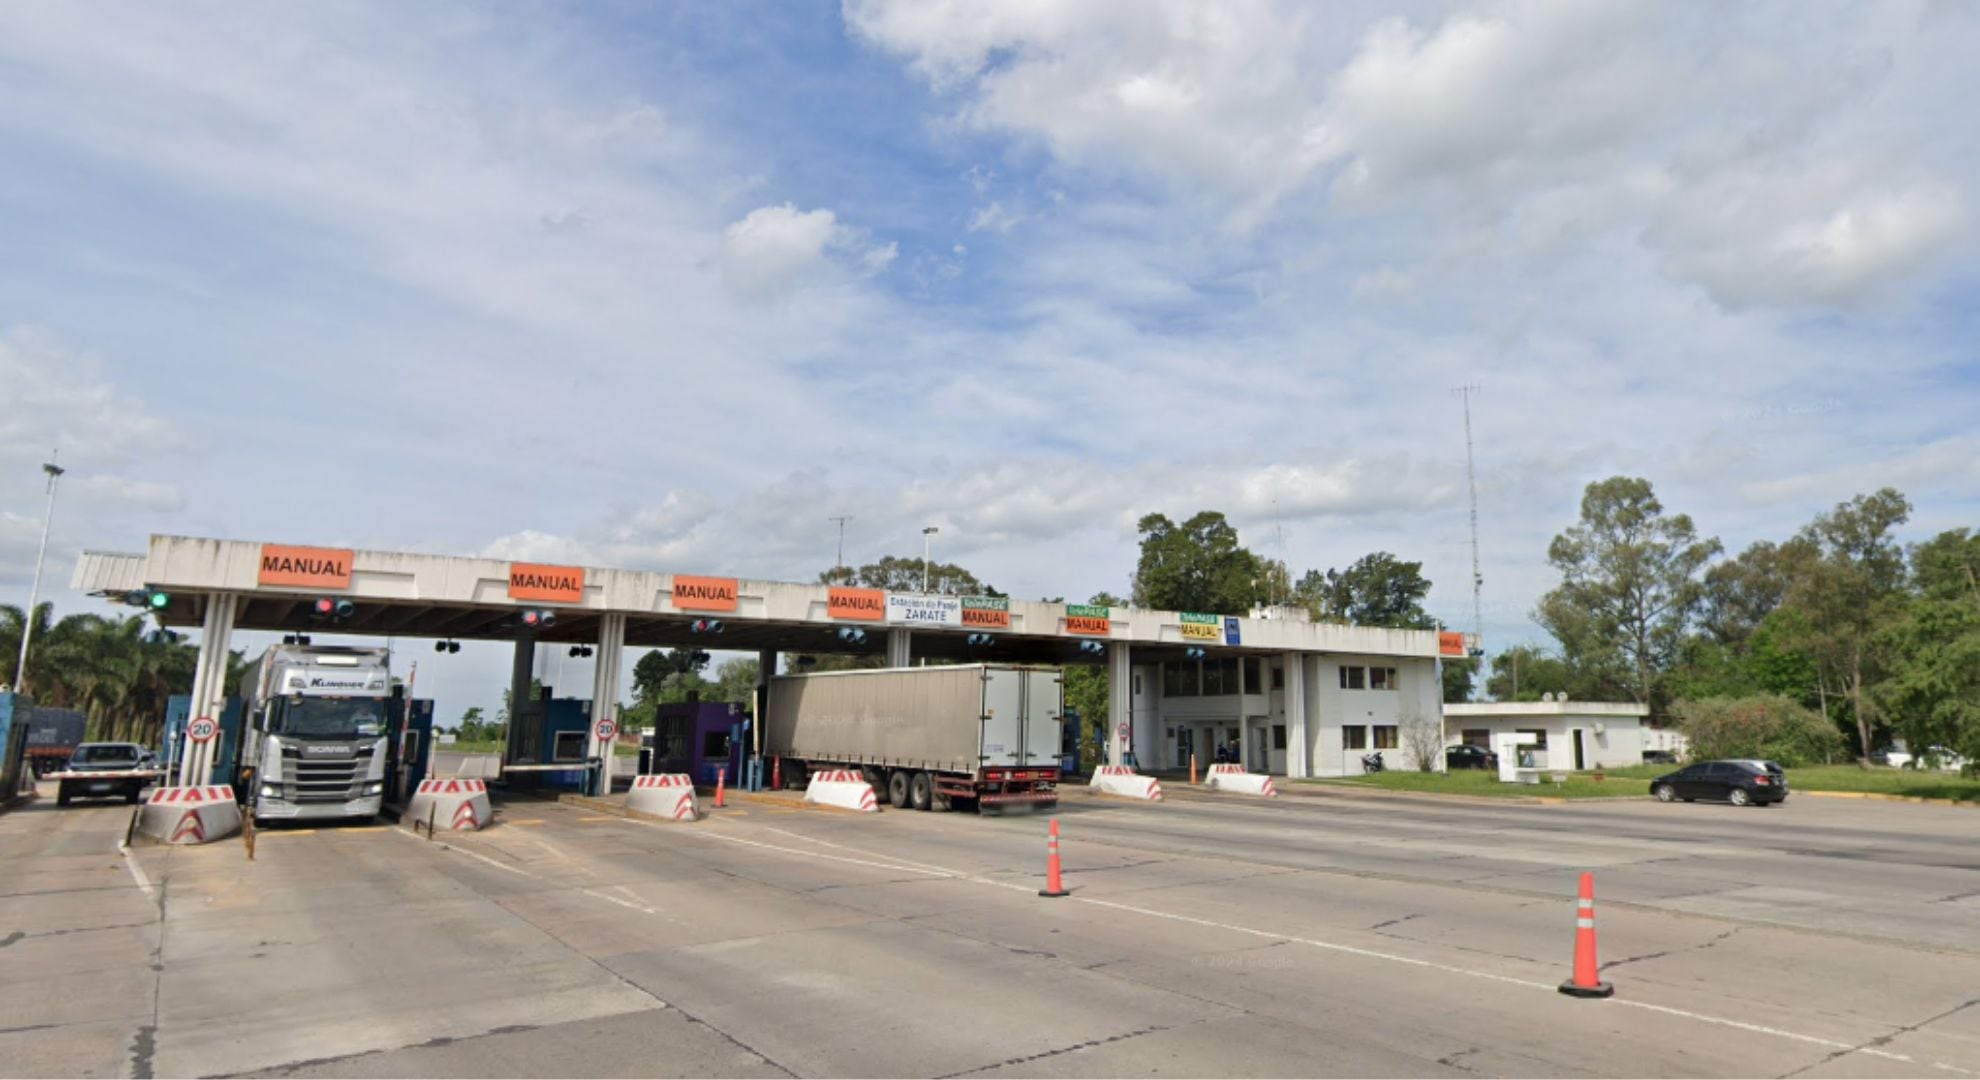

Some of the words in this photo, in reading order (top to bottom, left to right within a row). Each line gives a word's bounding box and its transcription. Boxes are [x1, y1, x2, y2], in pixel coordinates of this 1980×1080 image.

[262, 556, 347, 577] MANUAL
[511, 573, 581, 592] MANUAL
[675, 584, 735, 600] MANUAL
[830, 595, 881, 611] MANUAL
[905, 608, 947, 621] ZARATE
[962, 610, 1008, 625] MANUAL
[1067, 618, 1108, 631] MANUAL
[1181, 624, 1217, 637] MANUAL
[193, 723, 212, 735] 20
[599, 724, 613, 734] 20
